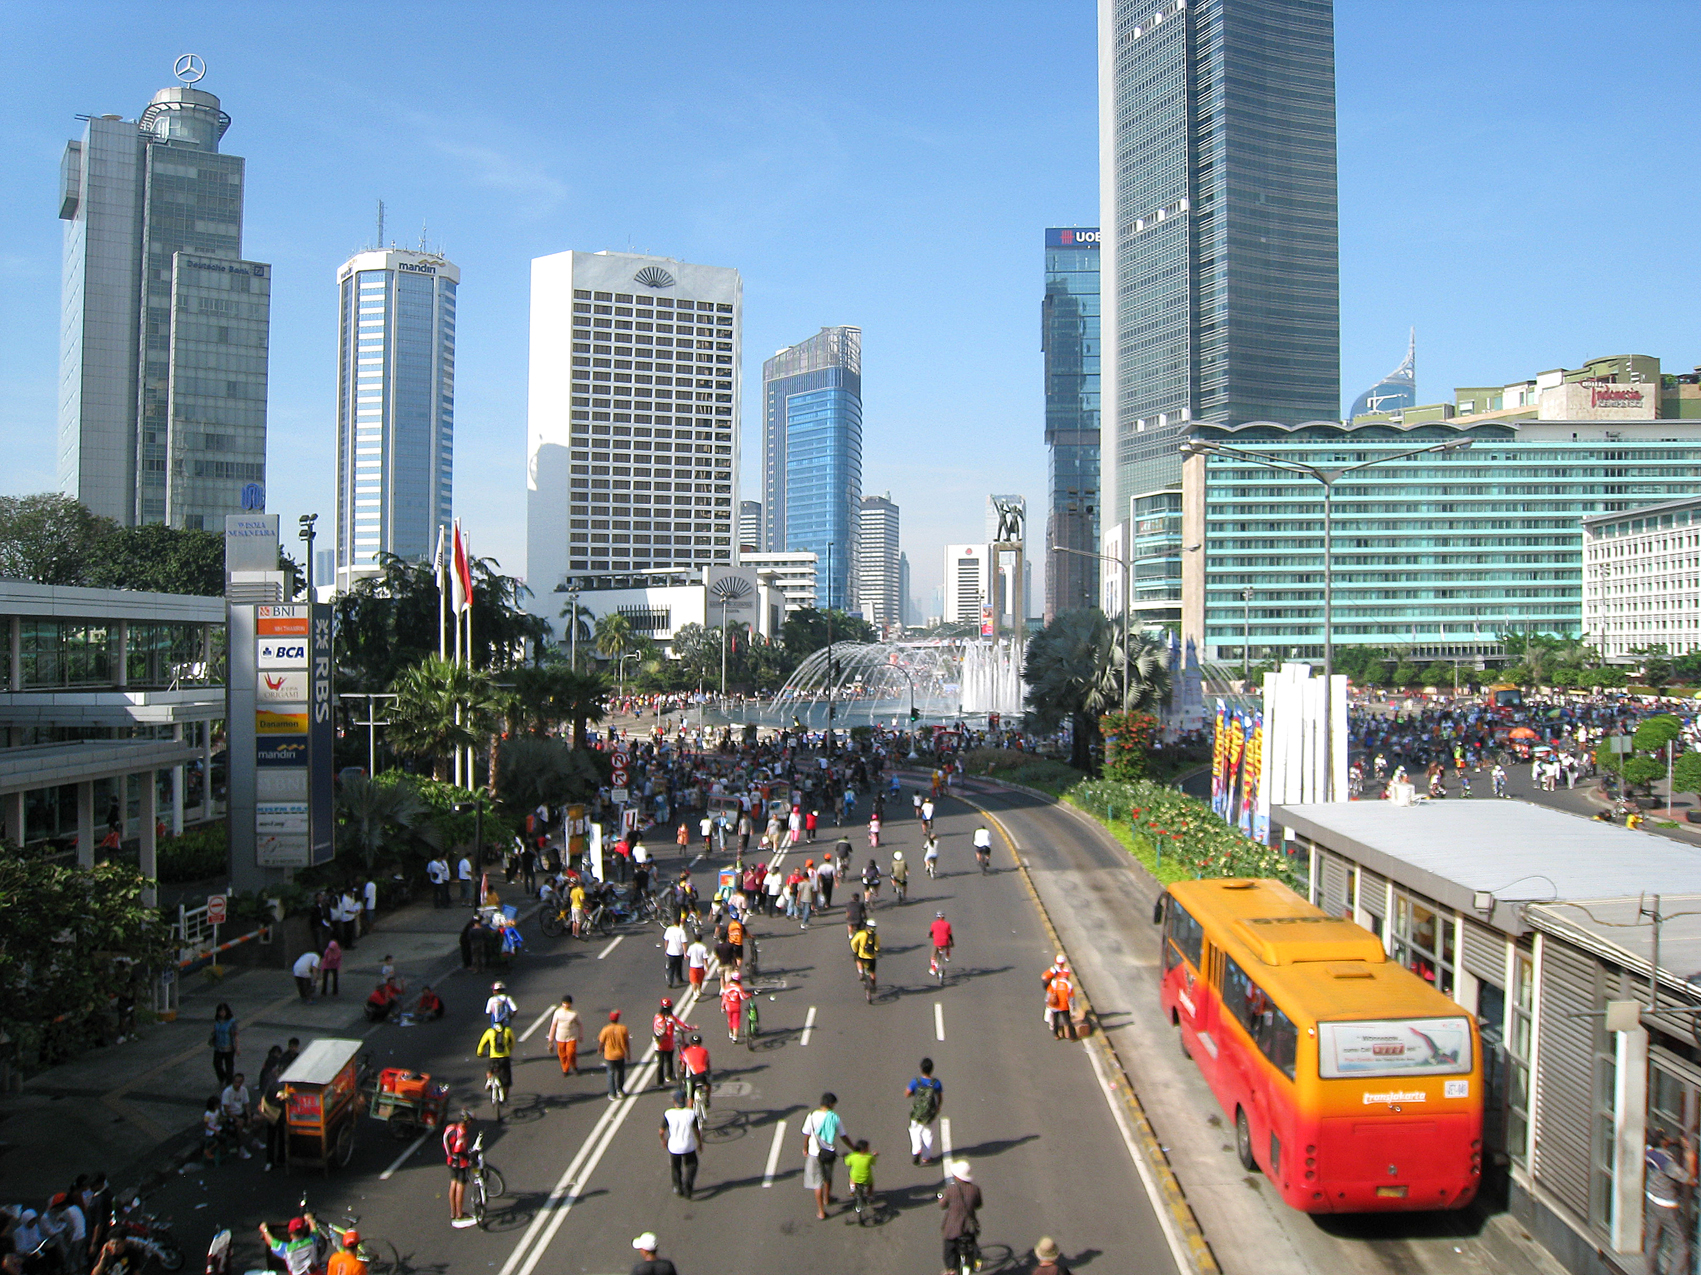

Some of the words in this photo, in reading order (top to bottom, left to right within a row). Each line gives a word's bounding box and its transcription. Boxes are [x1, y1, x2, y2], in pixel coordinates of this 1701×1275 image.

[187, 260, 226, 272] Deutsche
[229, 266, 250, 275] Bank
[228, 530, 277, 538] NUSANTARA
[273, 606, 295, 617] BNI
[276, 647, 305, 658] BCA
[264, 691, 299, 699] ORIGAMI
[316, 657, 330, 724] RBS
[258, 749, 296, 759] mandiri
[1363, 1092, 1426, 1104] transjakarta
